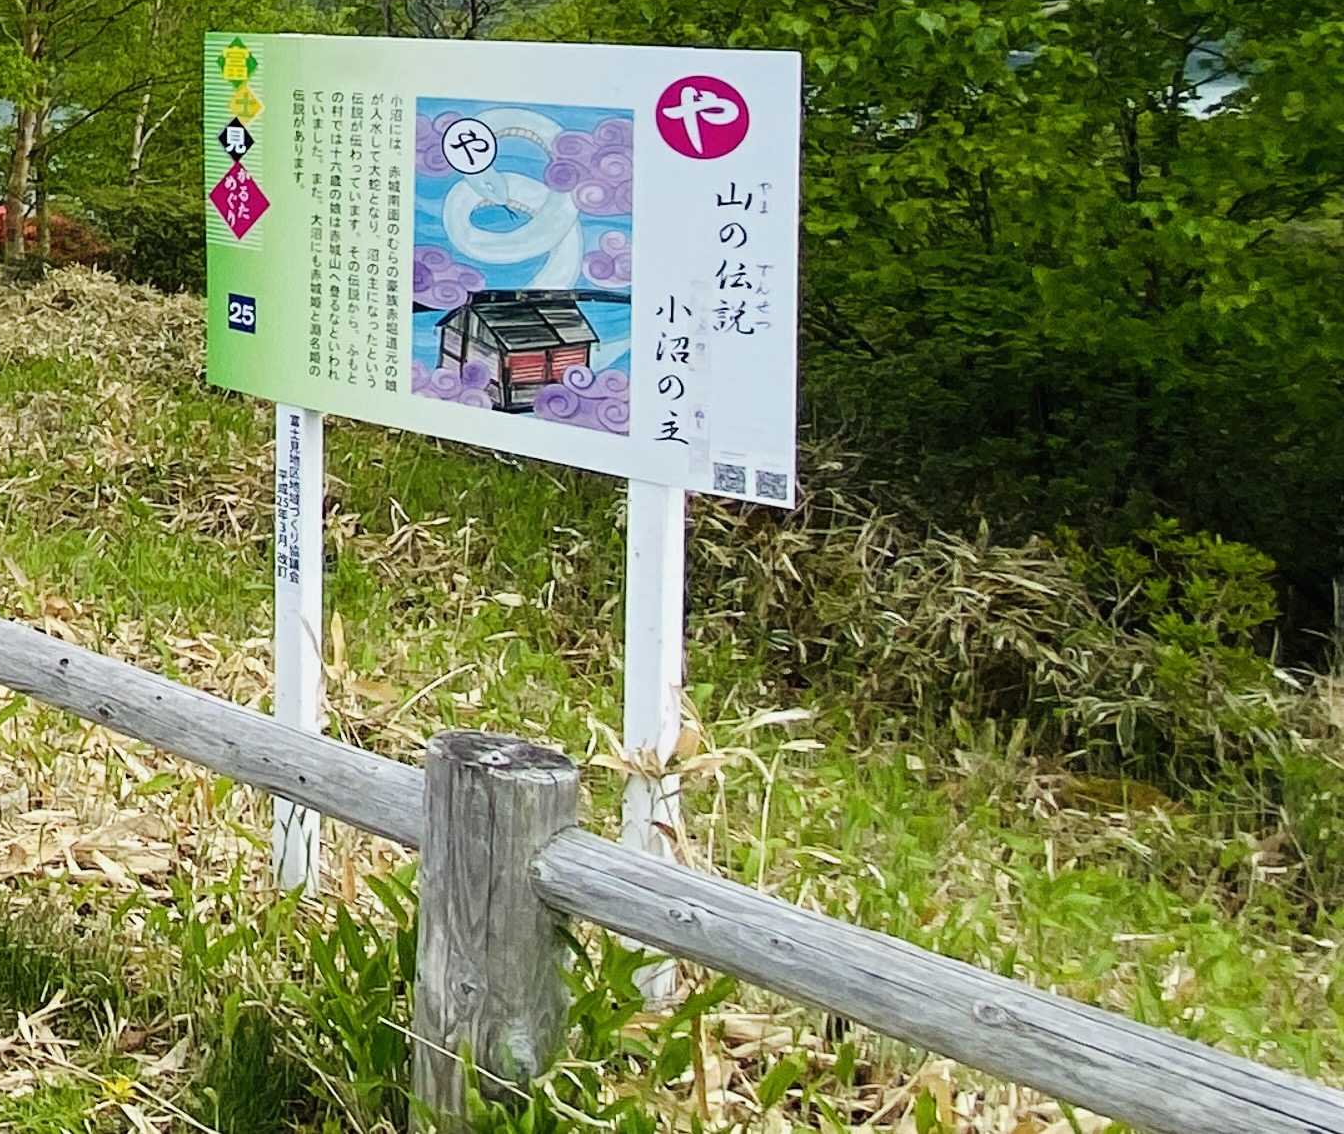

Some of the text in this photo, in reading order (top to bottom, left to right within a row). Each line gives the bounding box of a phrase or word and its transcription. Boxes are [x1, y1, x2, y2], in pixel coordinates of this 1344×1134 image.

[293, 89, 306, 189] 伝説があります。
[450, 129, 490, 166] や
[663, 86, 740, 155] や
[712, 182, 755, 335] 山の伝説
[229, 301, 255, 326] 25
[653, 295, 692, 445] 小沼の主
